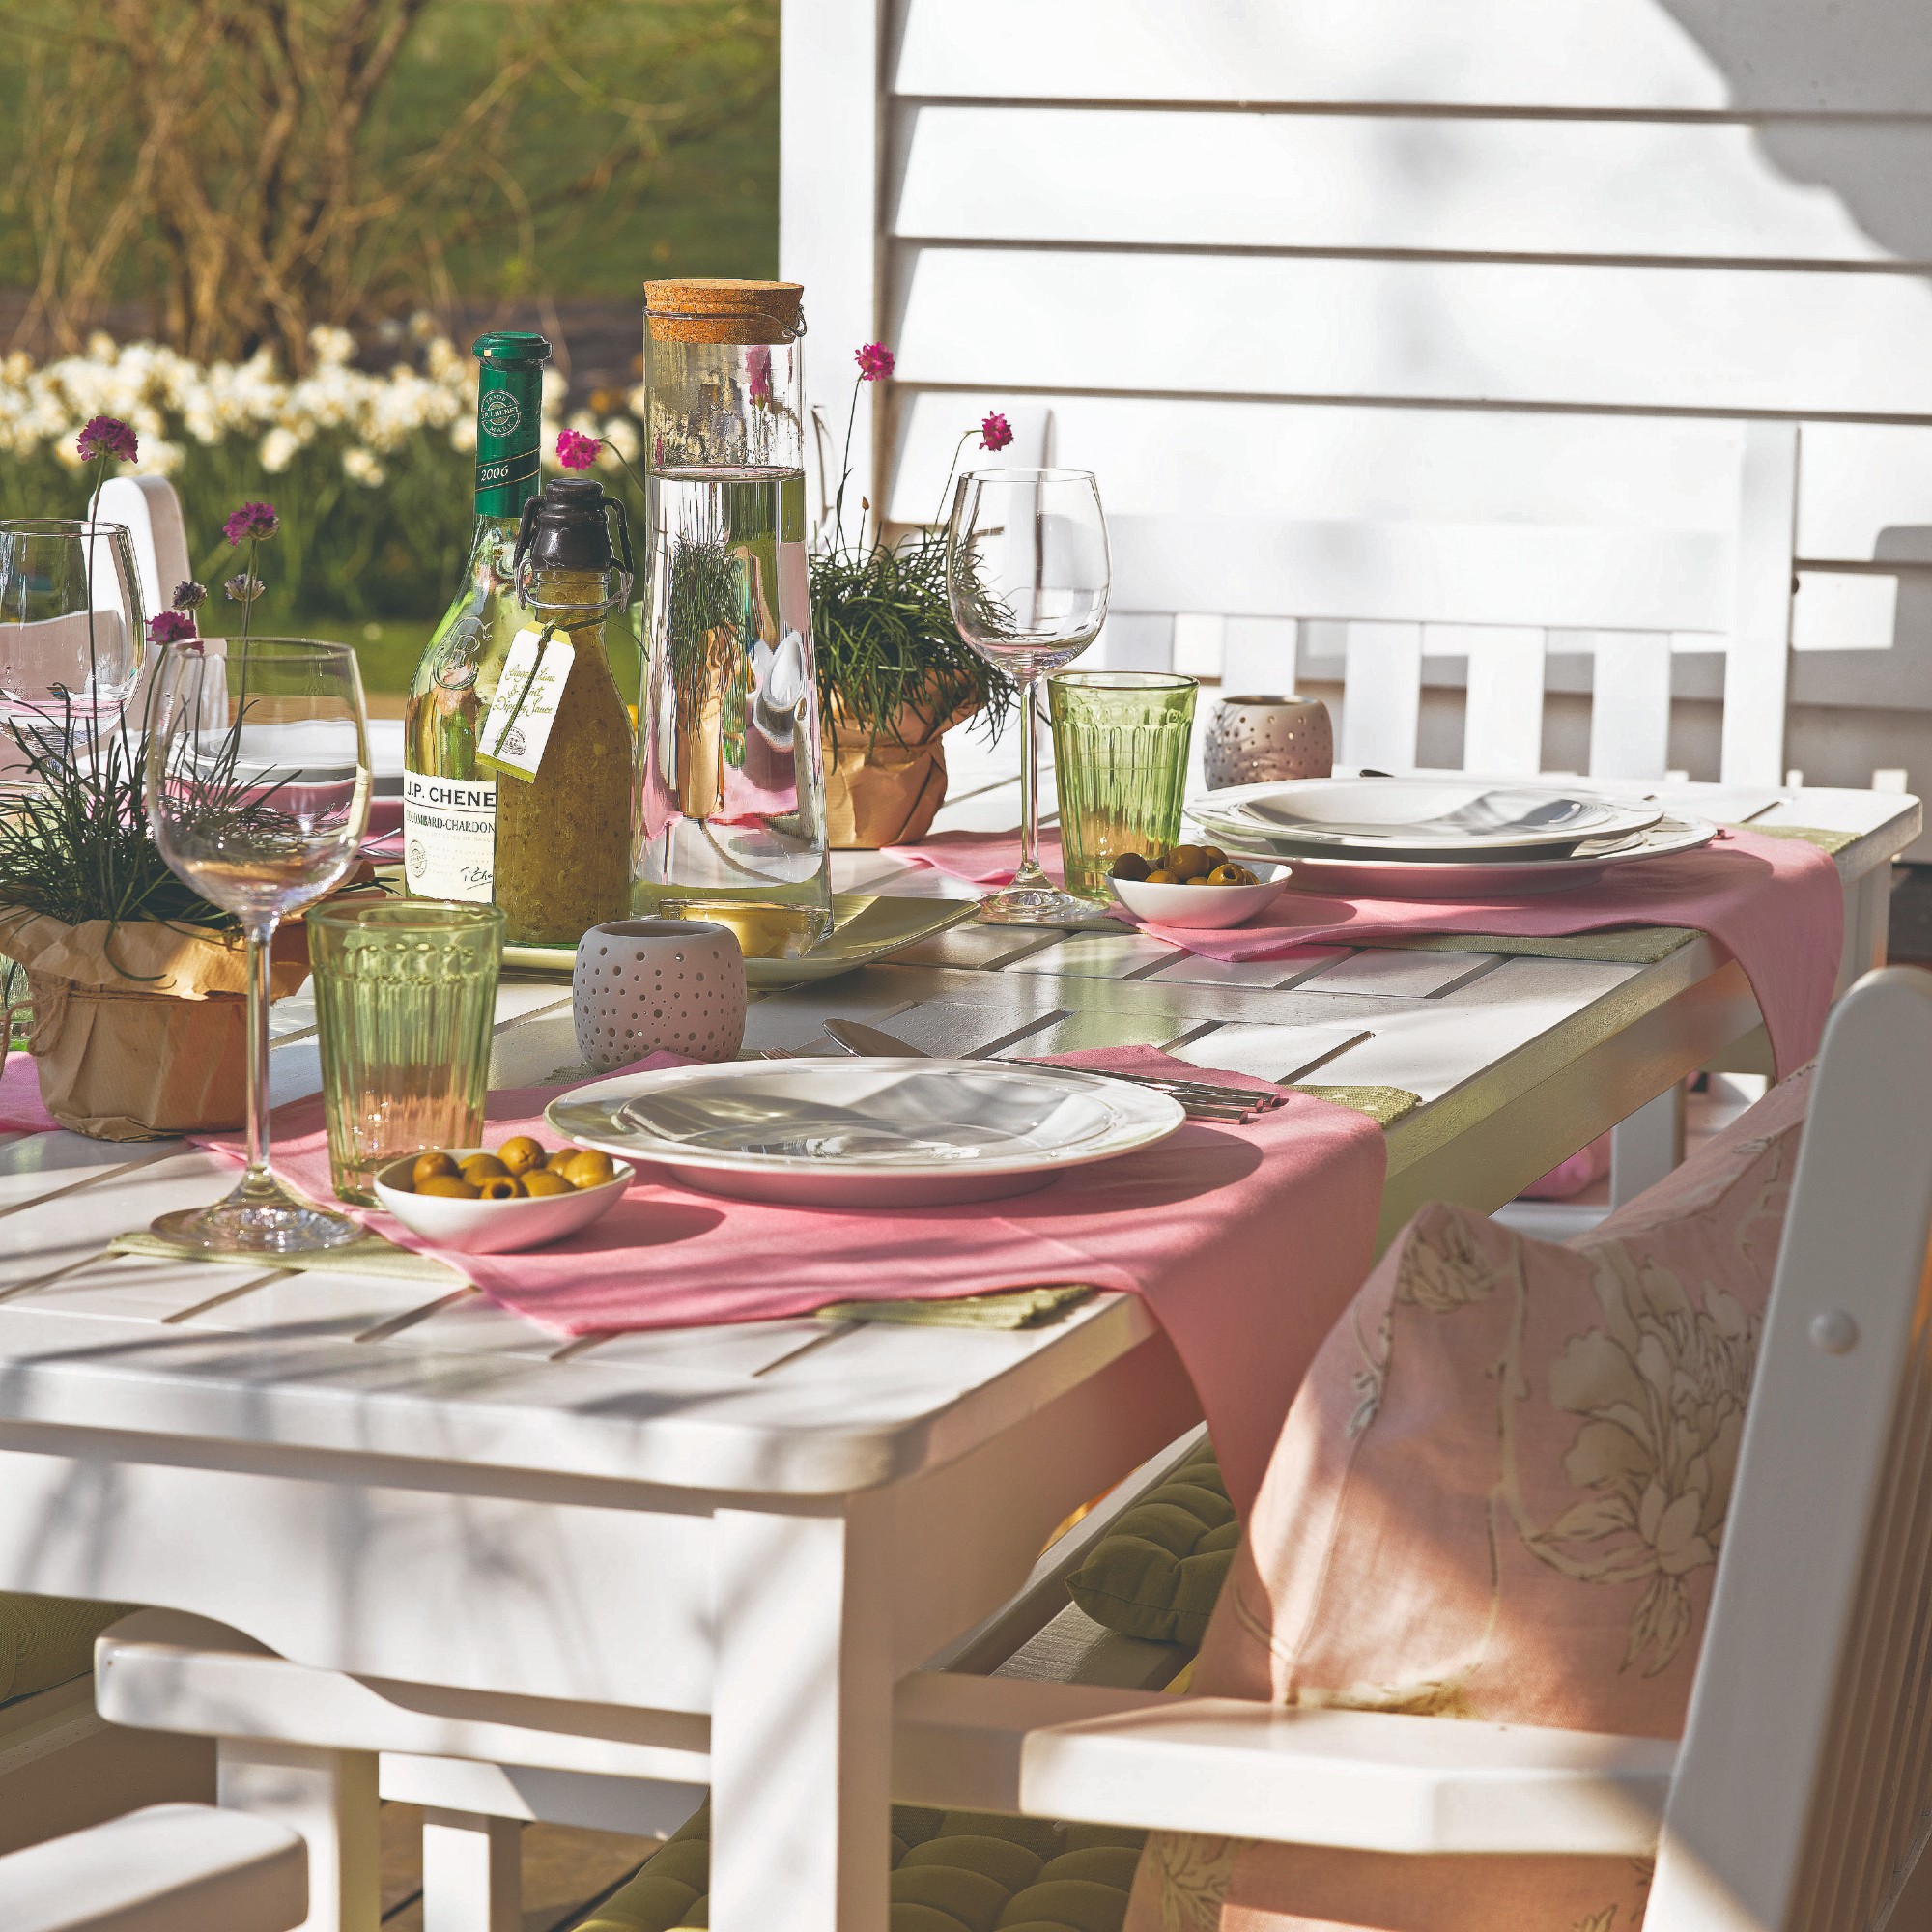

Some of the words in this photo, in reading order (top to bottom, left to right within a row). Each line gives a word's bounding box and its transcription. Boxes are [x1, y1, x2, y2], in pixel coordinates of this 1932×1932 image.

[485, 394, 507, 405] TRADE
[490, 406, 519, 417] CHENET
[489, 422, 514, 433] MARK
[480, 465, 509, 482] 2006
[407, 781, 425, 799] J.P.
